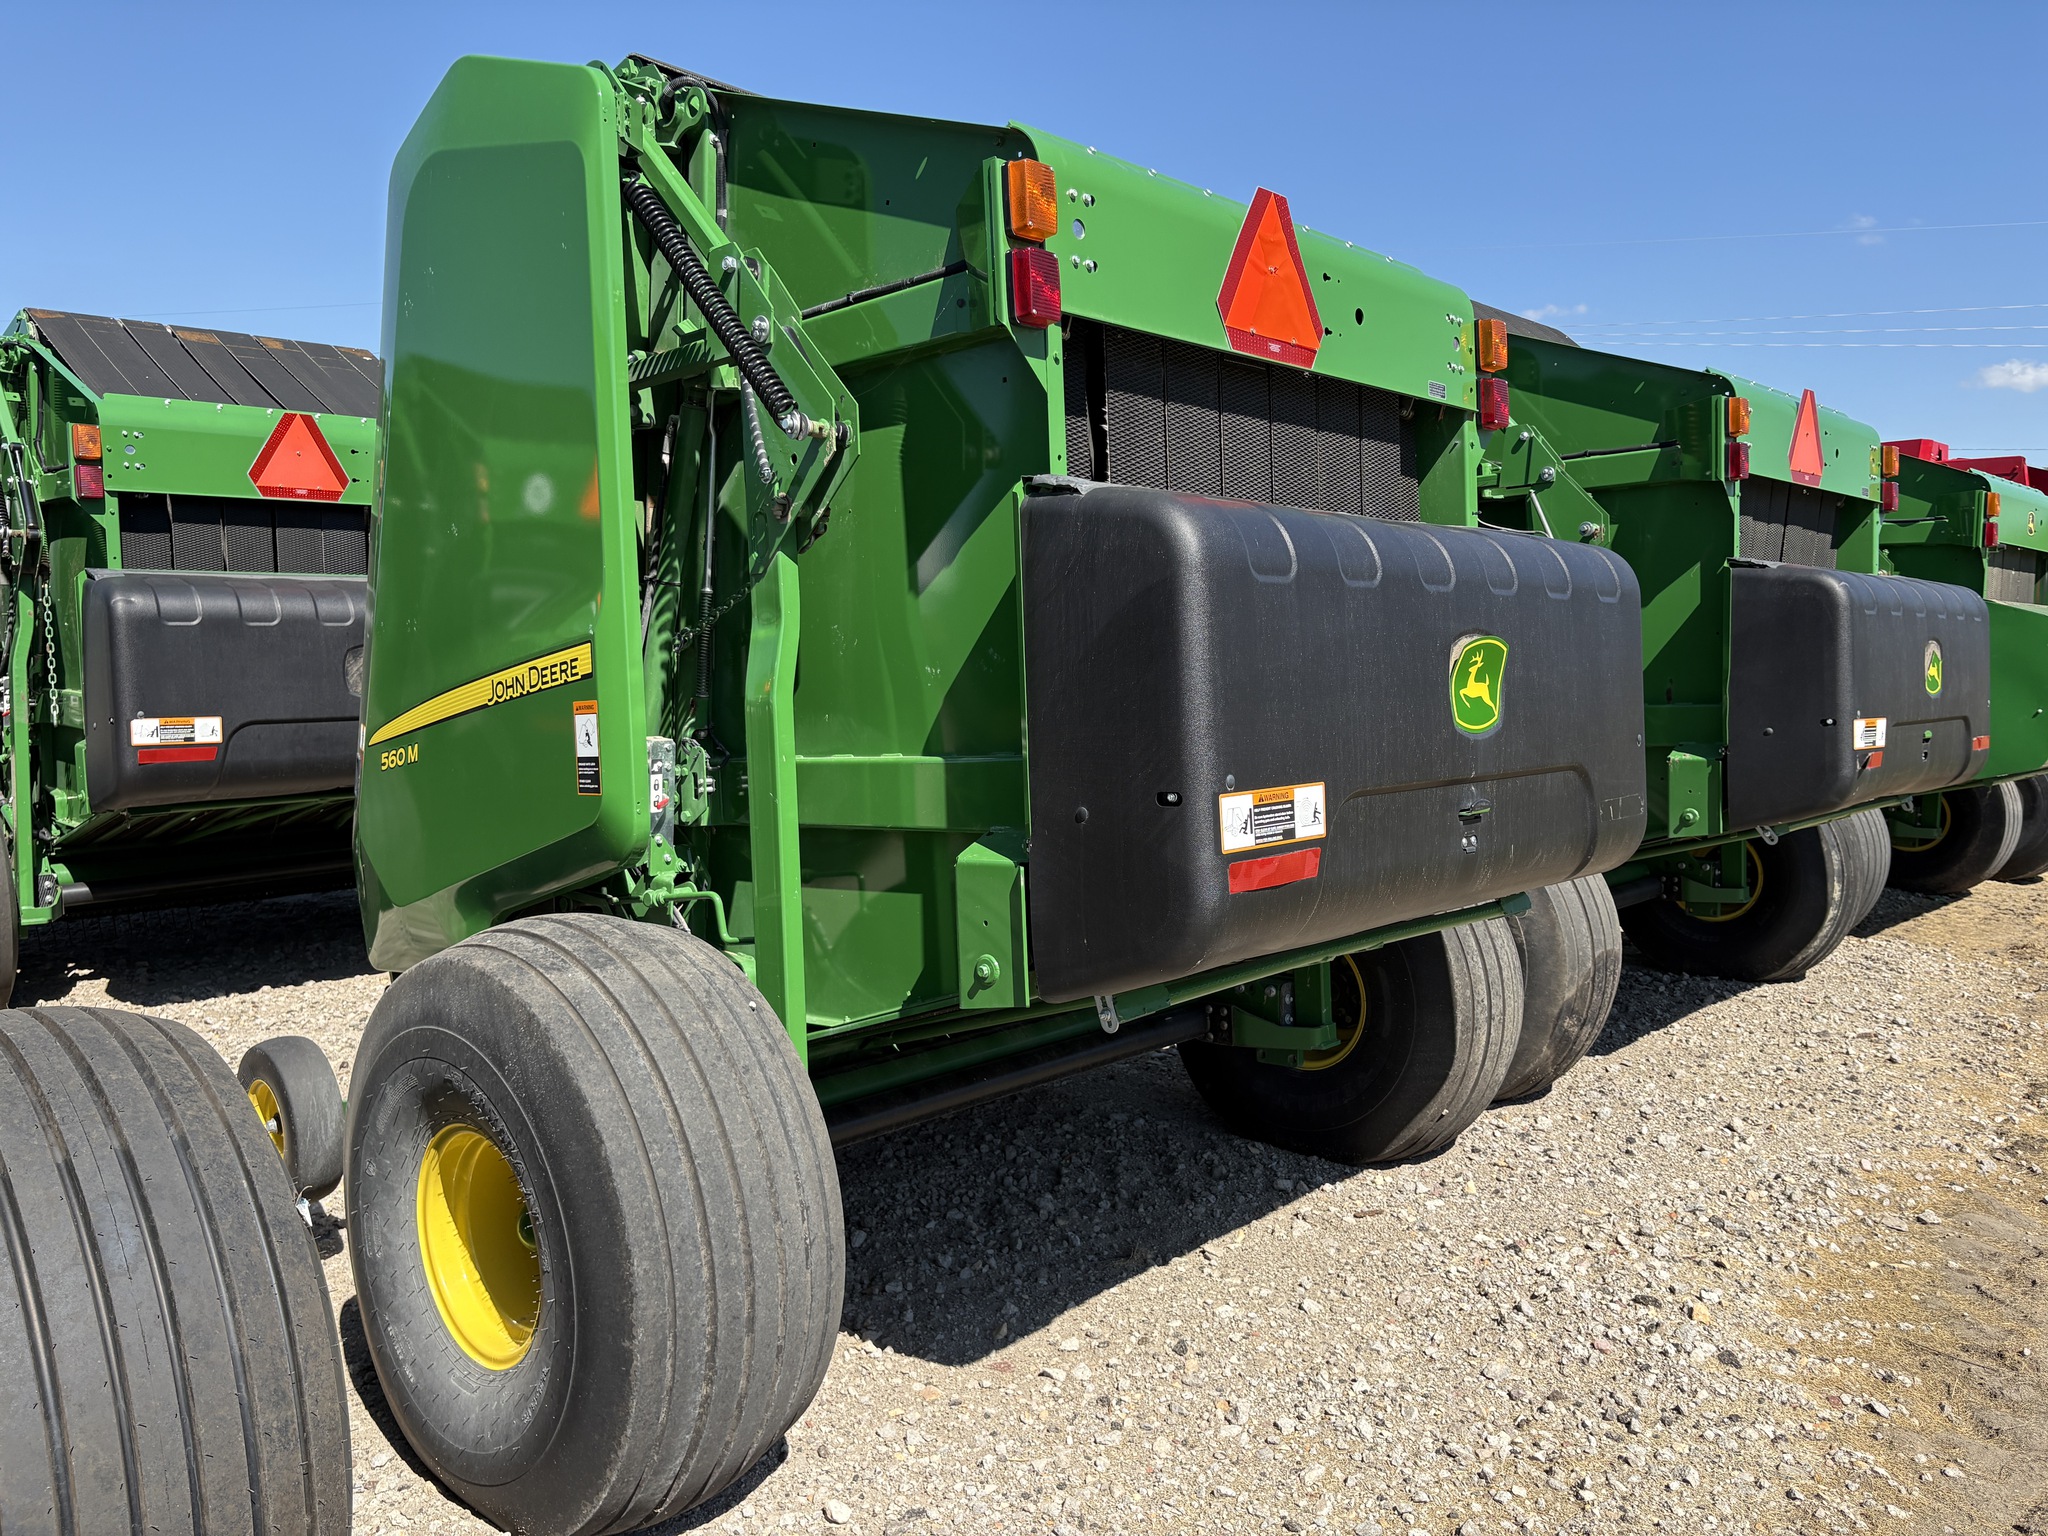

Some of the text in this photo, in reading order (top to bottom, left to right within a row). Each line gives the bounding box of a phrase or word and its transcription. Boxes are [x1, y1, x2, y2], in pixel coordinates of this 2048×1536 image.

[488, 657, 580, 703] JOHN DEERE
[381, 743, 419, 771] 560 M
[1263, 791, 1289, 802] WARNING
